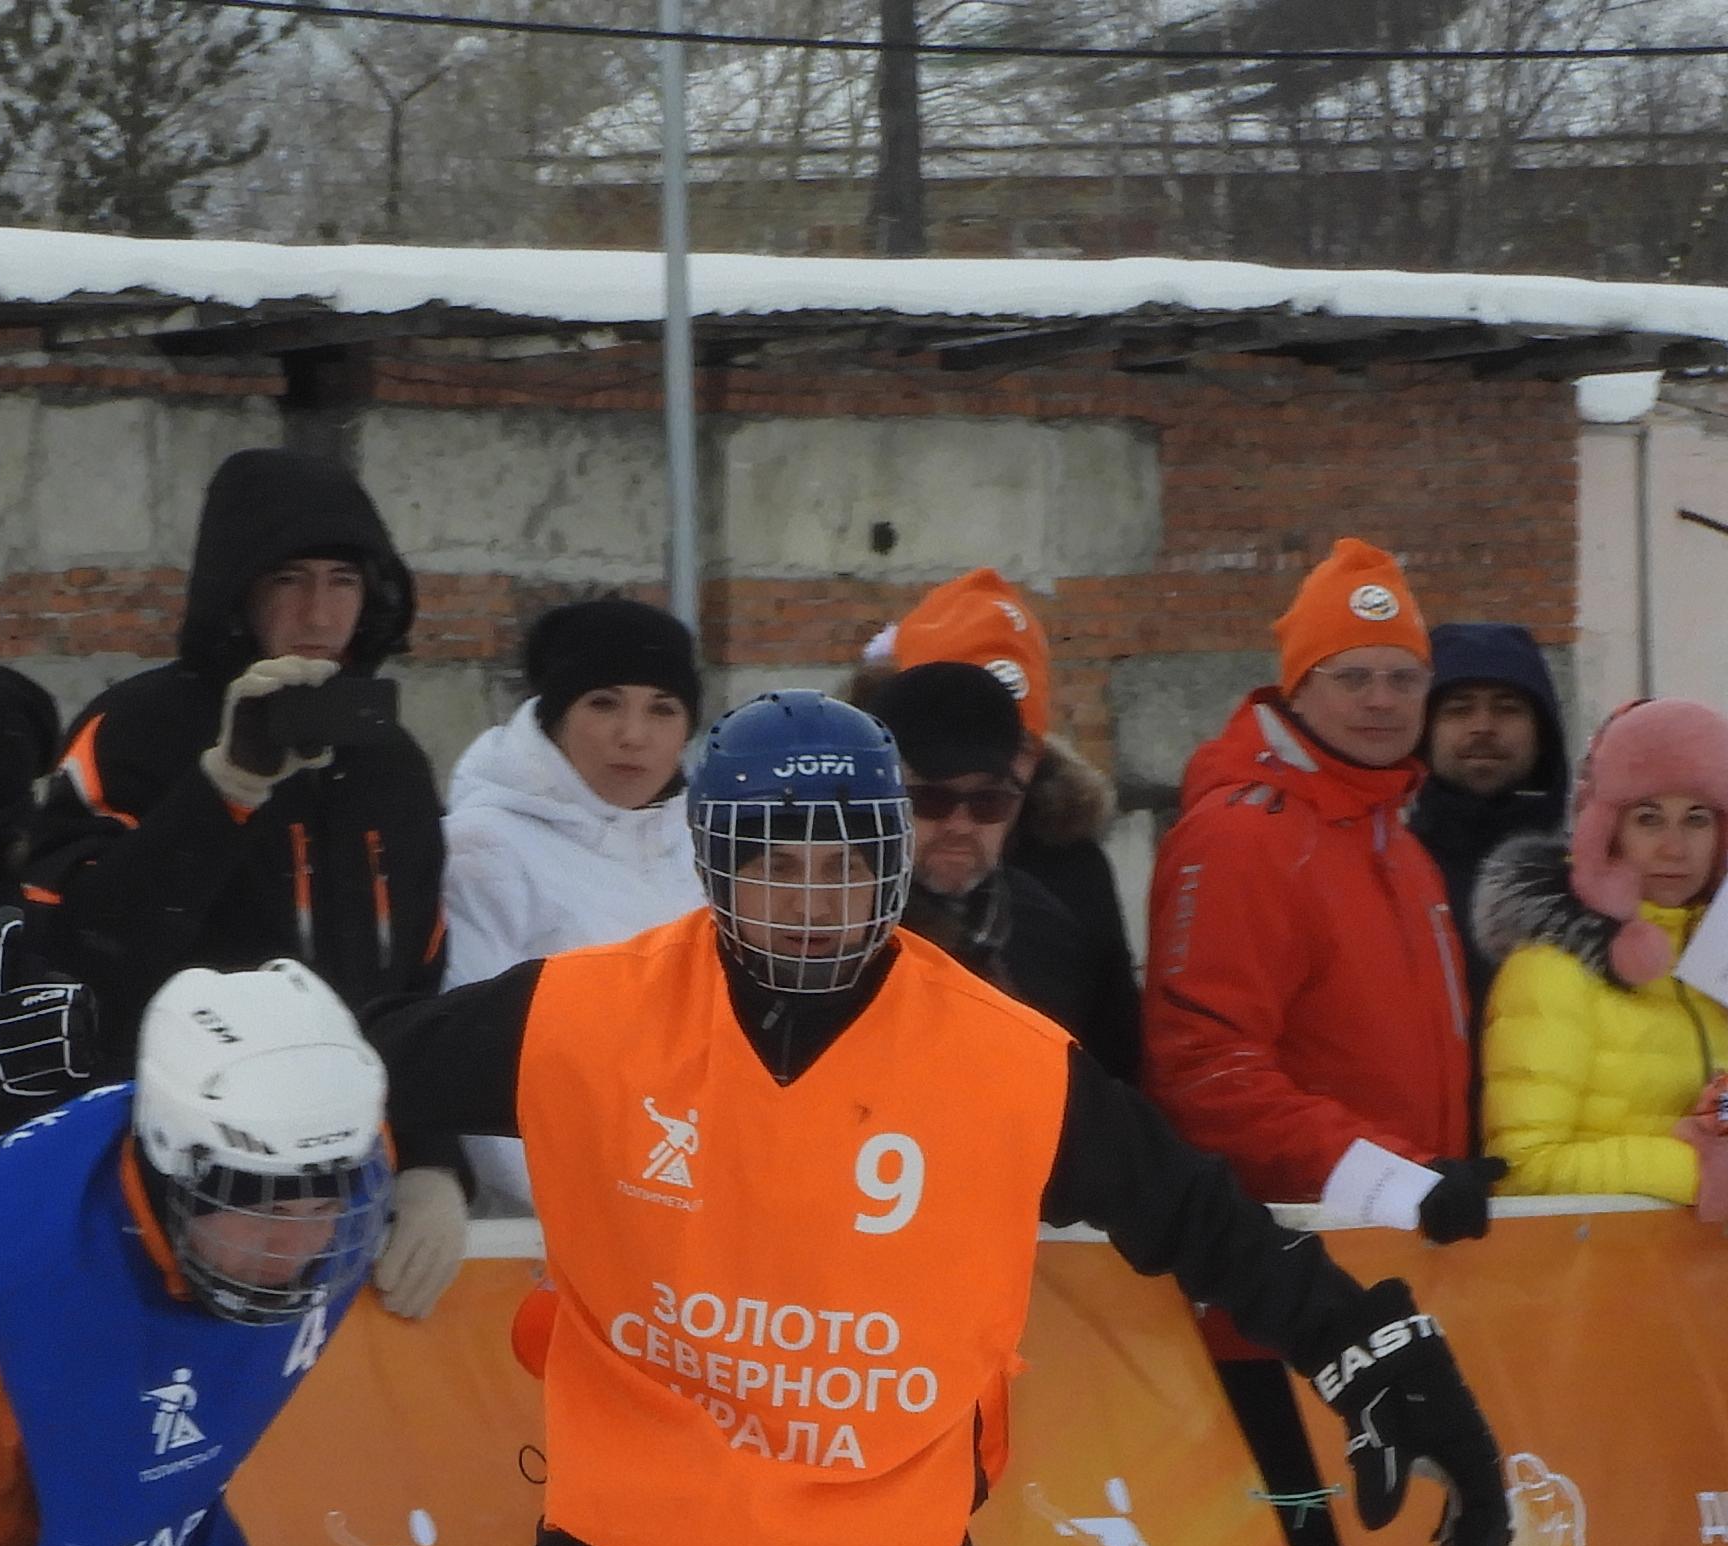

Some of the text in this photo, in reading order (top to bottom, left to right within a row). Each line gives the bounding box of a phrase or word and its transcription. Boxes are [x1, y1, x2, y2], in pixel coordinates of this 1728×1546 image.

[772, 754, 856, 778] JOFA
[854, 1132, 926, 1236] 9
[650, 1281, 901, 1356] ЗОЛОТО
[1314, 1314, 1445, 1403] EAST
[608, 1312, 940, 1413] СЕВЕРНОГО
[669, 1383, 867, 1469] РАЛА
